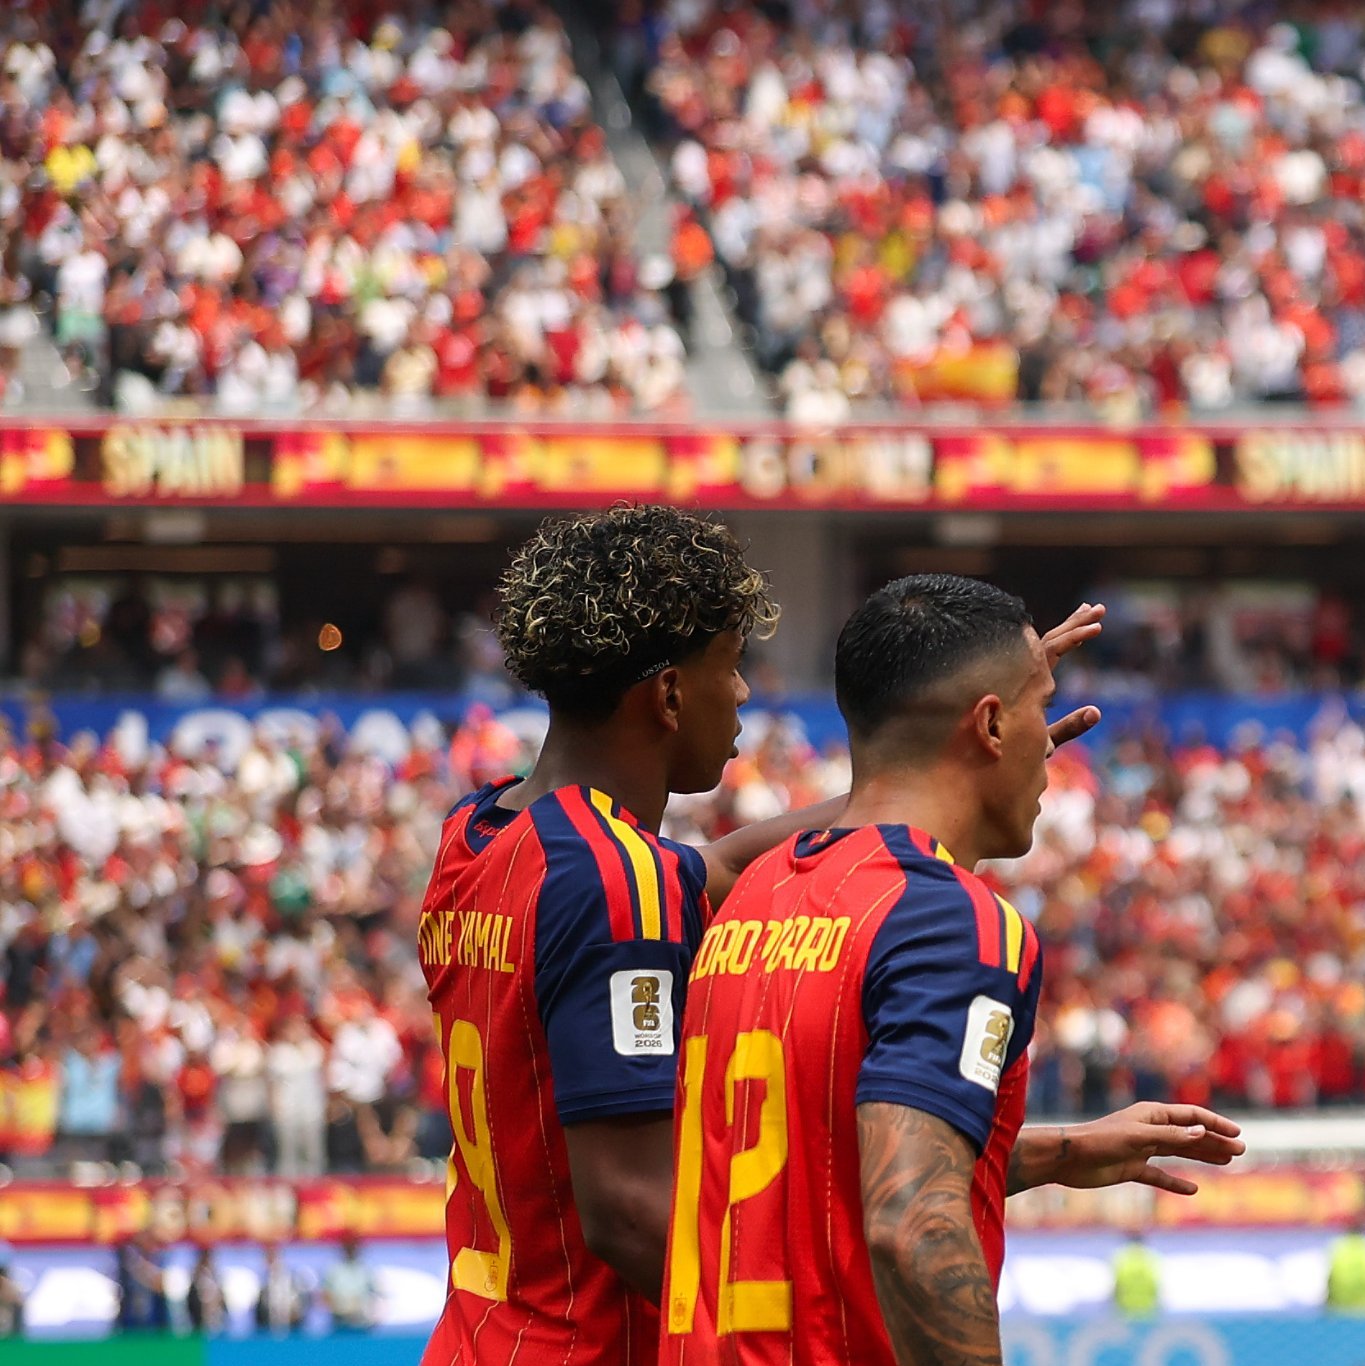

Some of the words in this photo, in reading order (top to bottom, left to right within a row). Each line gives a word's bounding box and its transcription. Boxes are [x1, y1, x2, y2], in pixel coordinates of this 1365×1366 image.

[458, 911, 514, 973] YAMAL
[688, 919, 763, 985] DRO
[635, 1039, 663, 1048] 2026
[432, 1012, 513, 1302] 9
[668, 1029, 794, 1338] 12
